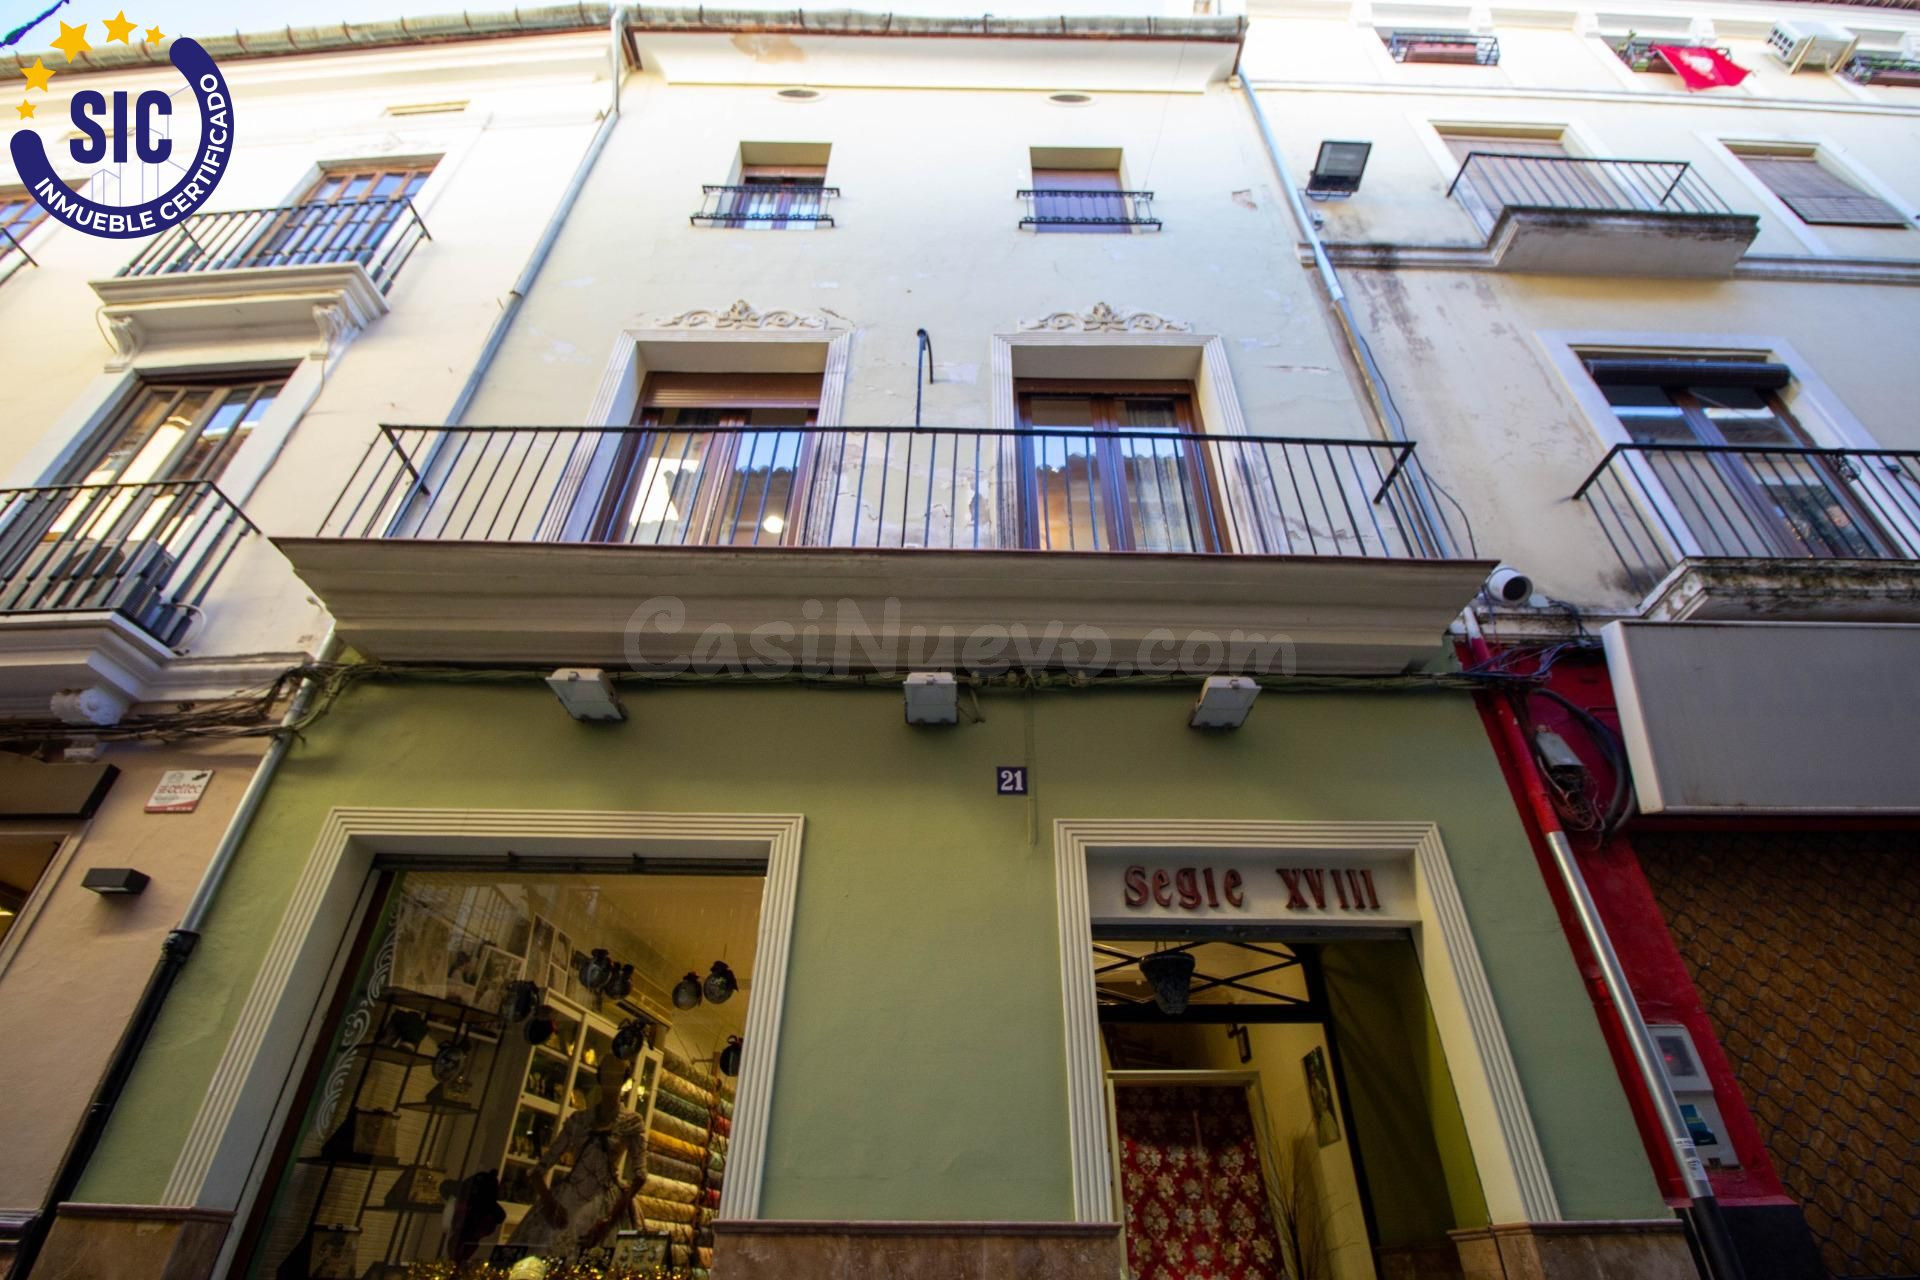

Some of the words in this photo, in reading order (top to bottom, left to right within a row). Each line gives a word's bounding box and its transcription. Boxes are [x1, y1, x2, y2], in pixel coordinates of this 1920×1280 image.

[1000, 770, 1024, 791] 21
[1124, 865, 1244, 909] Segle
[1275, 867, 1381, 909] XVIII
